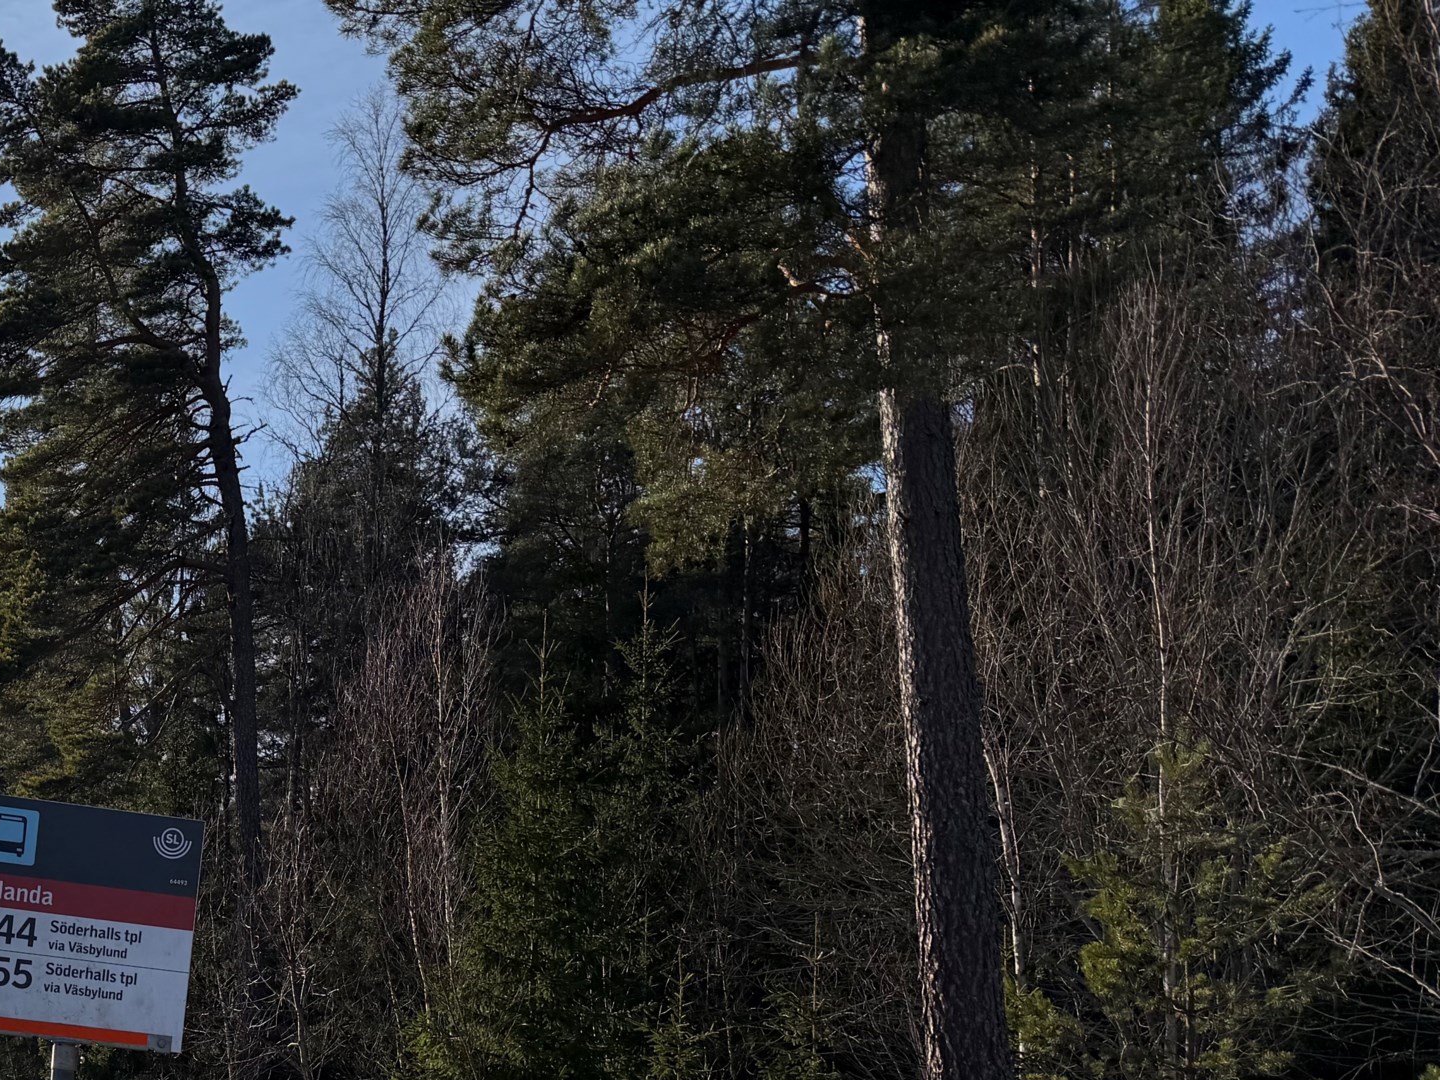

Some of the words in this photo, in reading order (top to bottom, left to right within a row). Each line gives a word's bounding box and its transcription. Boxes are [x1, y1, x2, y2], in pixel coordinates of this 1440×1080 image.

[166, 833, 179, 845] SL
[50, 920, 121, 941] Söderhalls
[124, 929, 142, 943] tpl
[48, 940, 65, 952] via
[68, 941, 127, 959] Väsbylund
[45, 962, 116, 983] Söderhalls
[119, 970, 138, 986] tpl
[44, 982, 60, 994] via
[64, 983, 123, 1001] Väsbylund
